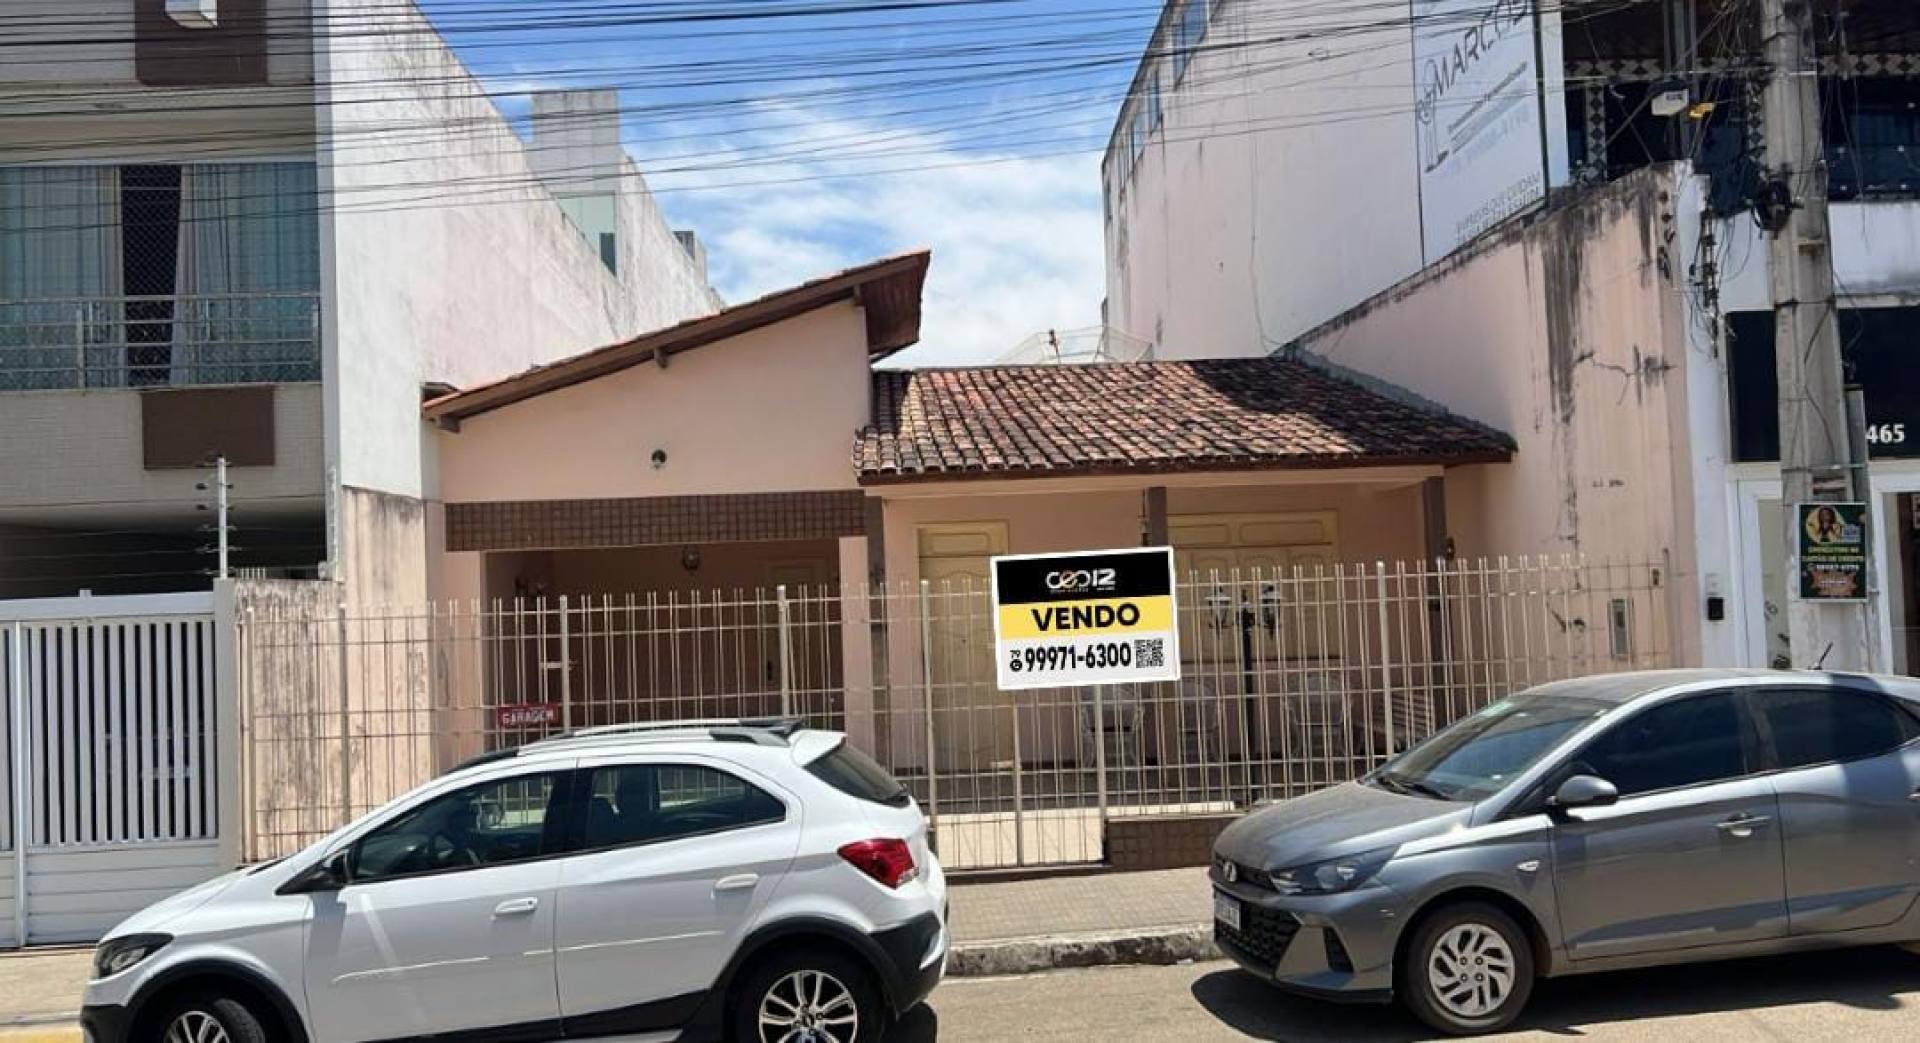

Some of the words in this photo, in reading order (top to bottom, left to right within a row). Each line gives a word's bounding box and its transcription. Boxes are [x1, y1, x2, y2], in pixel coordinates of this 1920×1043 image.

[1865, 424, 1905, 443] 465
[1031, 602, 1140, 631] VENDO
[1025, 642, 1131, 672] 99971-6300
